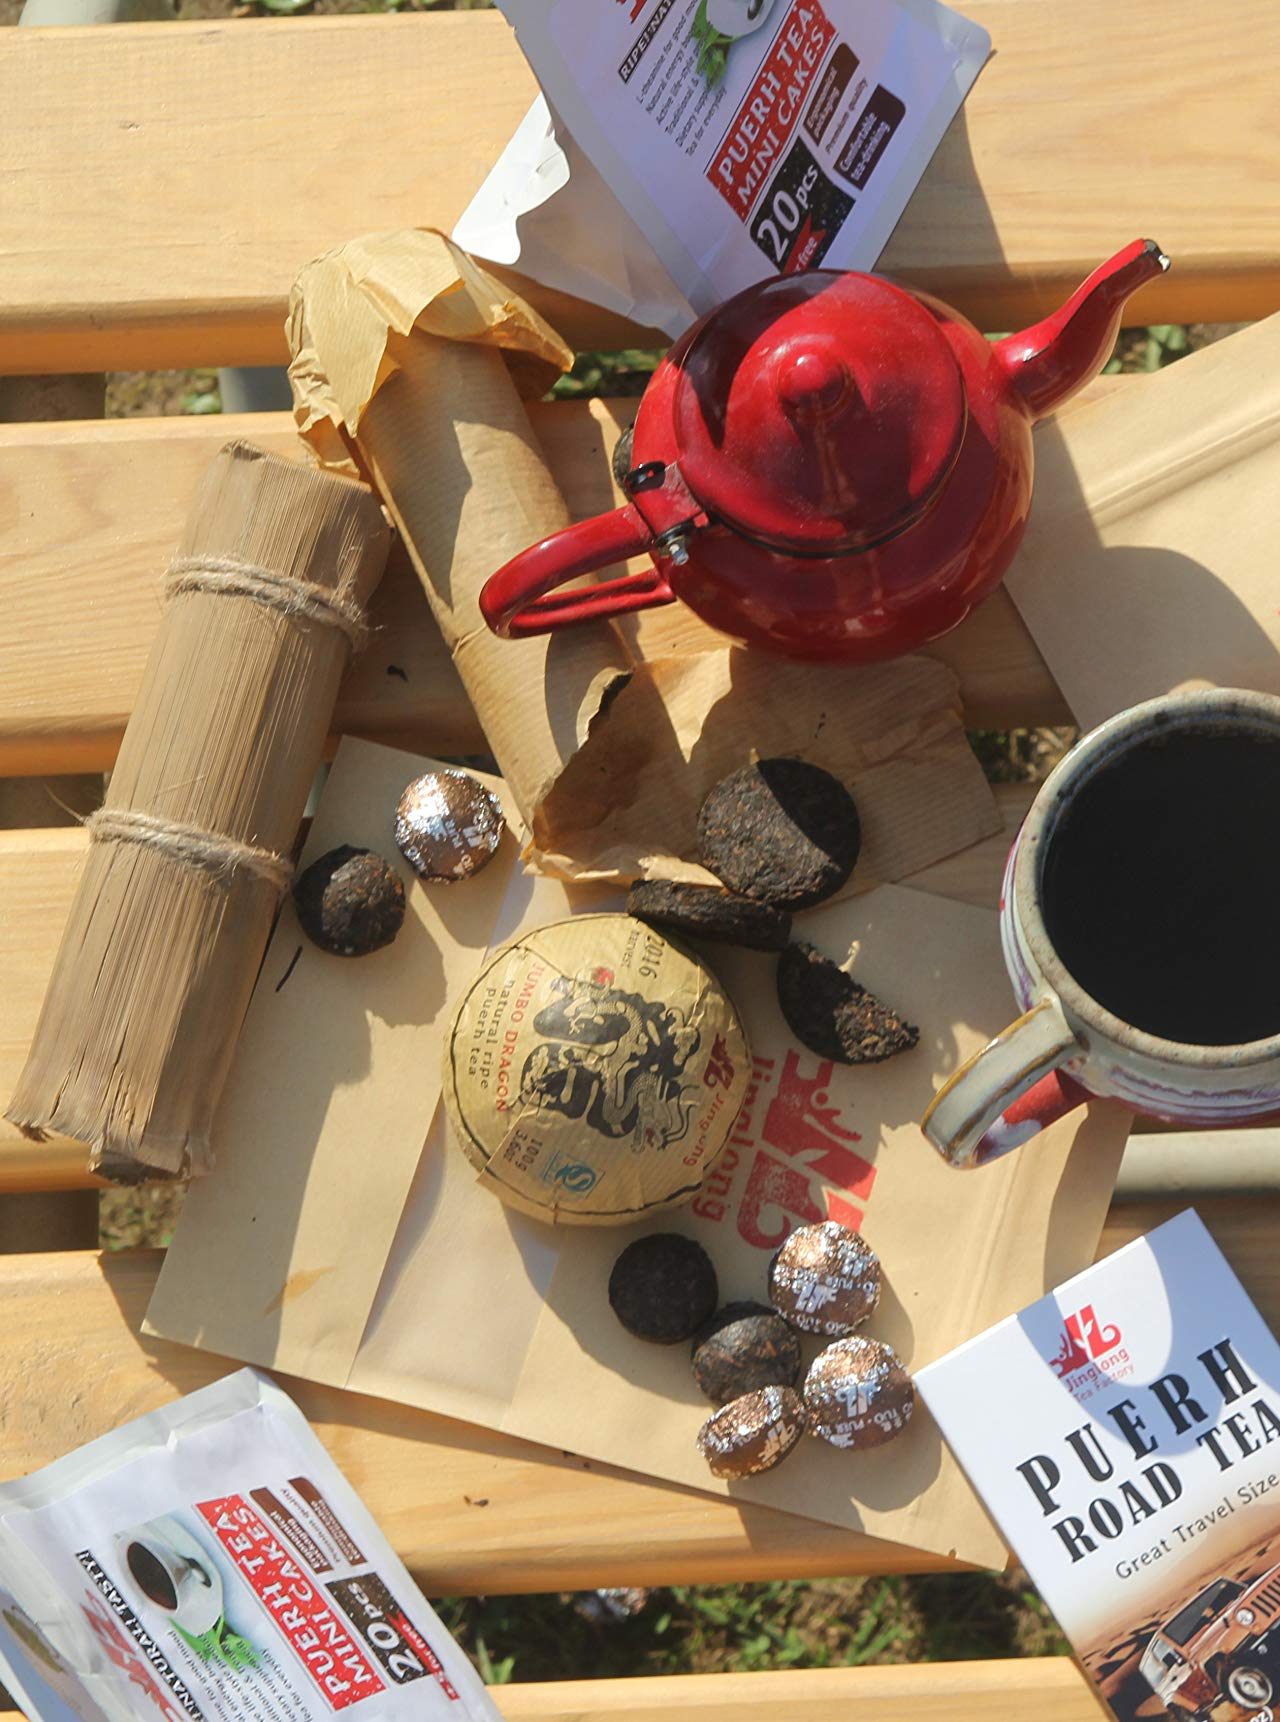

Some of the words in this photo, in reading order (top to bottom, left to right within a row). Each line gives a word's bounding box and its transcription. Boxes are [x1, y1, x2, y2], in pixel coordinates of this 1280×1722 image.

[663, 38, 673, 54] for
[645, 77, 668, 115] Natural
[664, 47, 686, 81] energy
[655, 95, 674, 126] Active
[715, 70, 782, 185] PUERH
[776, 8, 815, 66] TEA
[665, 90, 692, 136] Traditional
[676, 113, 698, 148] Dietary
[685, 138, 699, 158] Tea
[702, 84, 730, 127] everyday
[736, 129, 782, 206] MINI
[774, 25, 828, 126] CAKES
[798, 234, 818, 266] free
[620, 928, 640, 970] harvest
[636, 933, 665, 979] 2016
[472, 986, 497, 1041] puerh
[484, 978, 516, 1046] natural
[508, 961, 544, 1025] JUMBO
[467, 1046, 481, 1075] tea
[476, 1049, 494, 1090] ripe
[495, 1028, 517, 1111] DRAGON
[513, 1136, 543, 1173] 100g
[1065, 1347, 1129, 1393] Jinglong
[1073, 1386, 1093, 1403] Tea
[1093, 1362, 1136, 1393] Factory
[1014, 1336, 1259, 1518] PUERH
[1050, 1456, 1188, 1563] ROAD
[1113, 1536, 1172, 1581] Great
[1172, 1496, 1235, 1545] Travel
[1236, 1470, 1280, 1505] Size
[216, 1510, 265, 1573] TEA
[232, 1505, 315, 1603] CAKES
[76, 1552, 130, 1614] TASTY!
[125, 1617, 196, 1706] NATURAL!
[262, 1580, 352, 1694] PUERH
[310, 1608, 373, 1681] MINI
[401, 1622, 426, 1648] free
